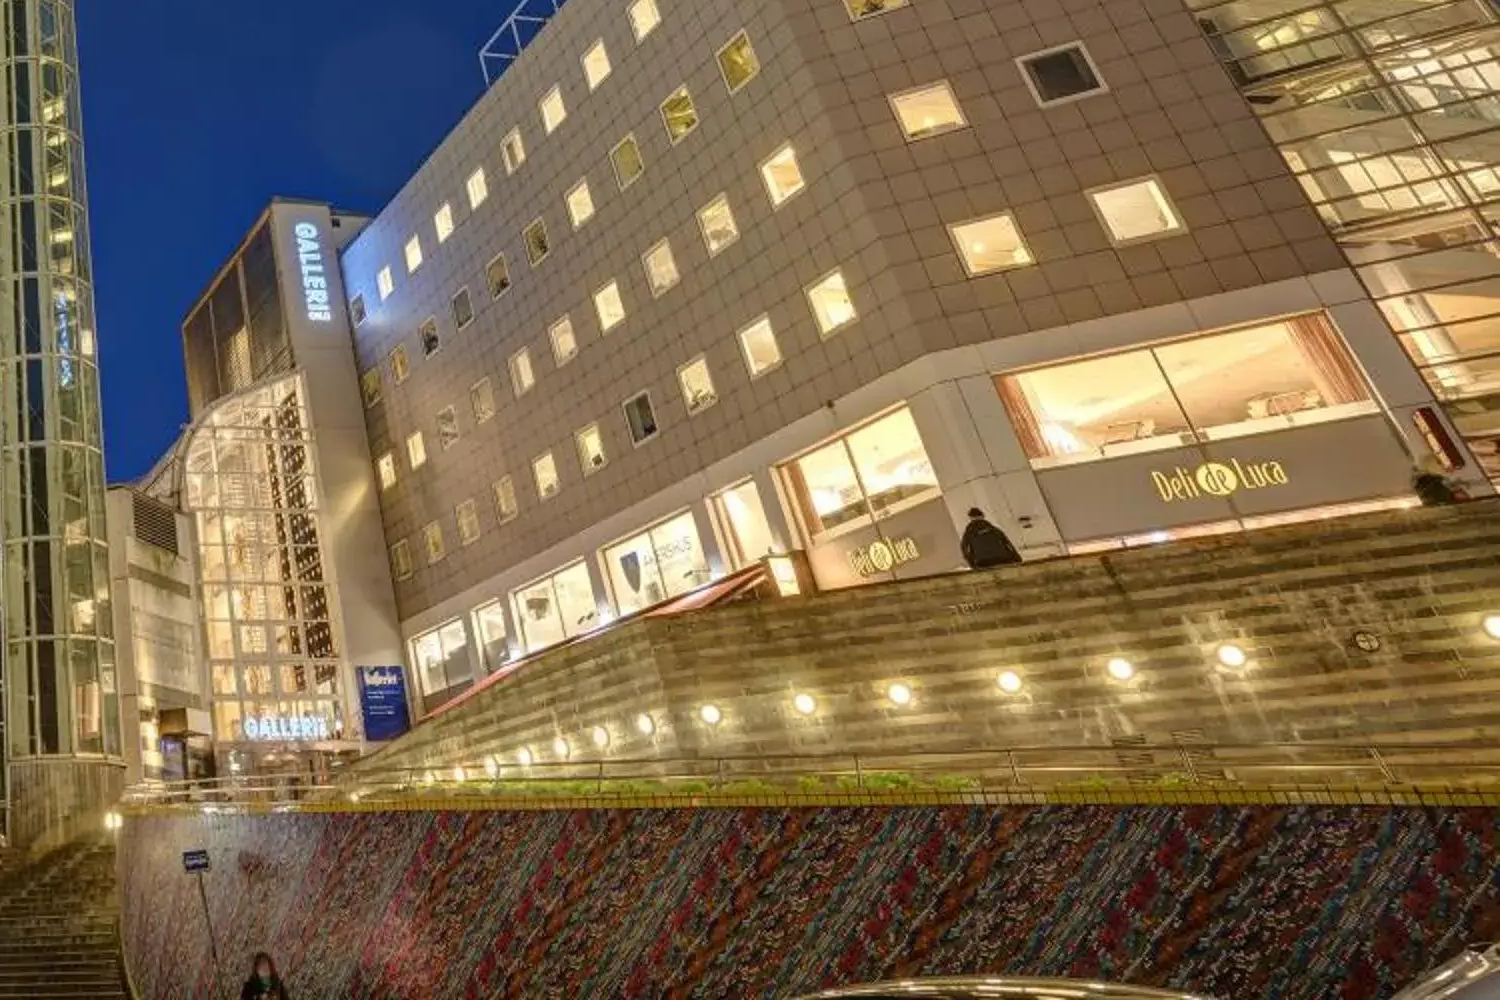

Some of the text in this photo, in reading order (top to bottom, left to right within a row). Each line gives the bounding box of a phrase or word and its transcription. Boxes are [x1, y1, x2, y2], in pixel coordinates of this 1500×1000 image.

[295, 222, 330, 311] GALLERI
[1151, 466, 1201, 502] Deli
[1230, 457, 1289, 489] Luca
